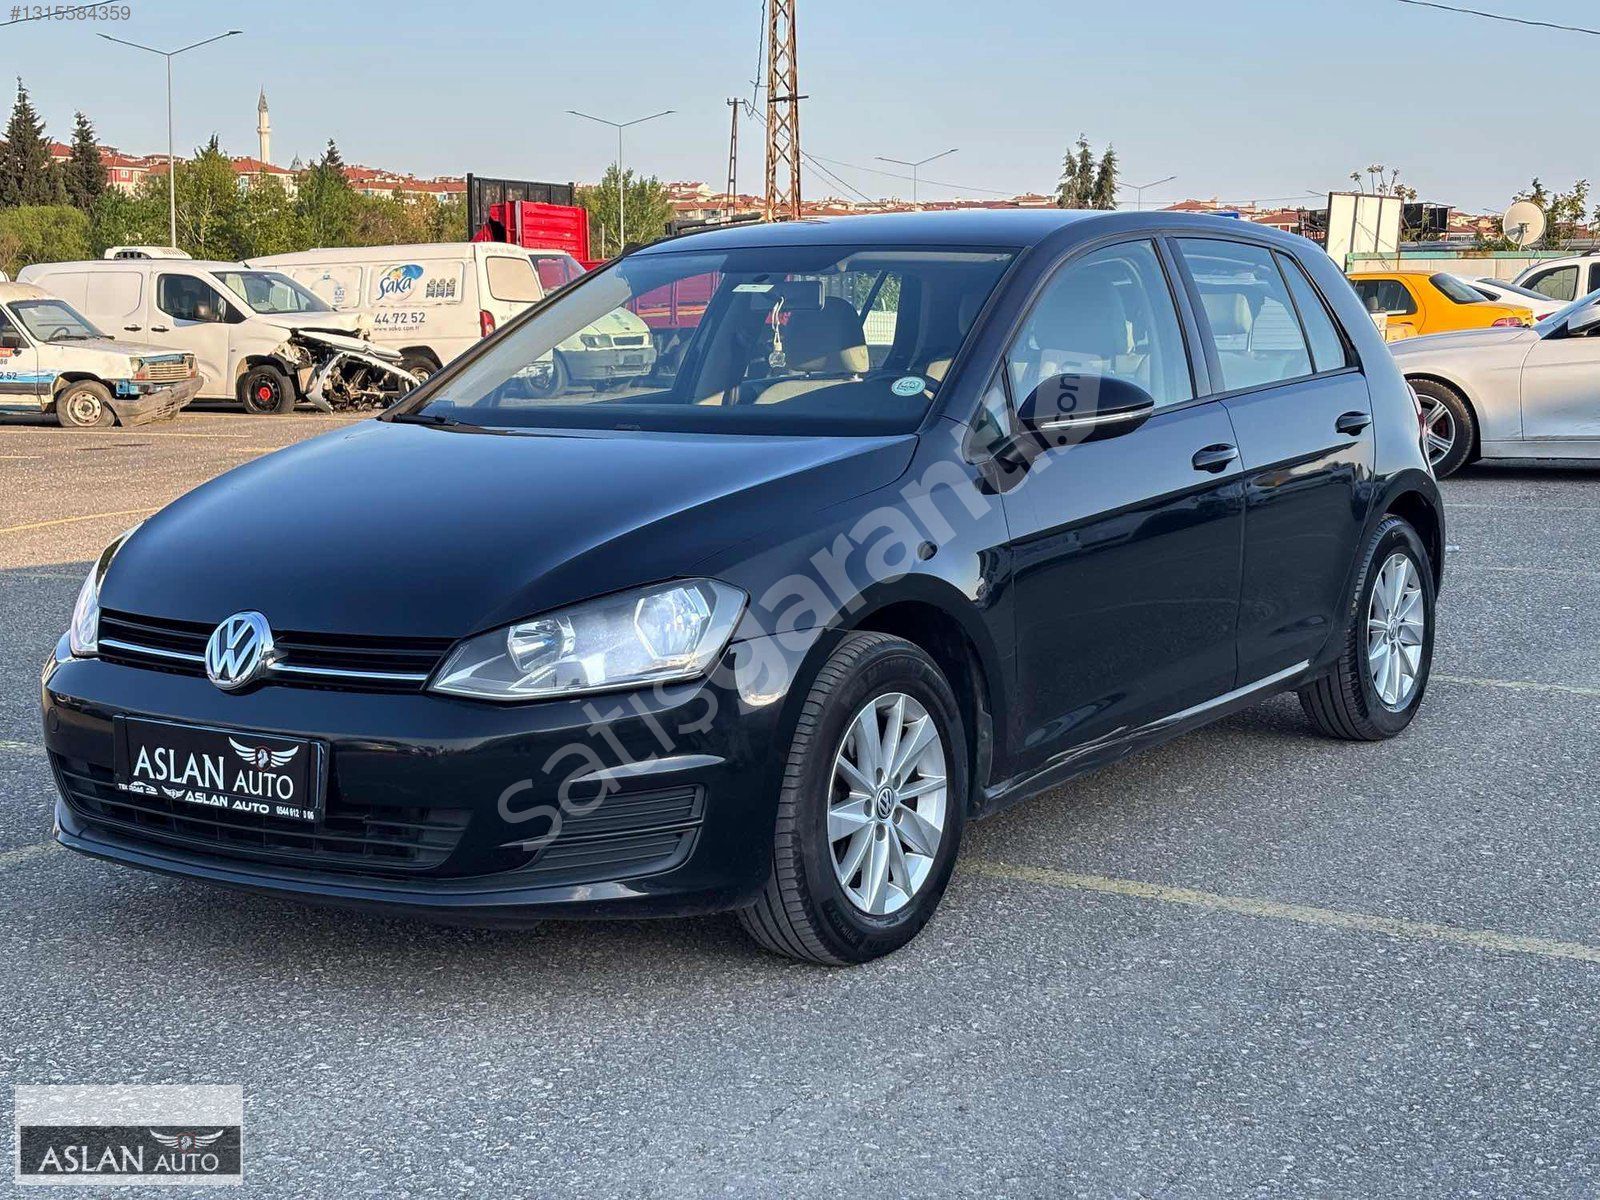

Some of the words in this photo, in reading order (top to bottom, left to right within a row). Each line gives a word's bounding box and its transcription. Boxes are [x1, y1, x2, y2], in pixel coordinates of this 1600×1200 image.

[133, 744, 225, 791] ASLAN
[232, 769, 294, 800] AUTO
[184, 790, 229, 808] ASLAN
[232, 799, 270, 815] AUTO
